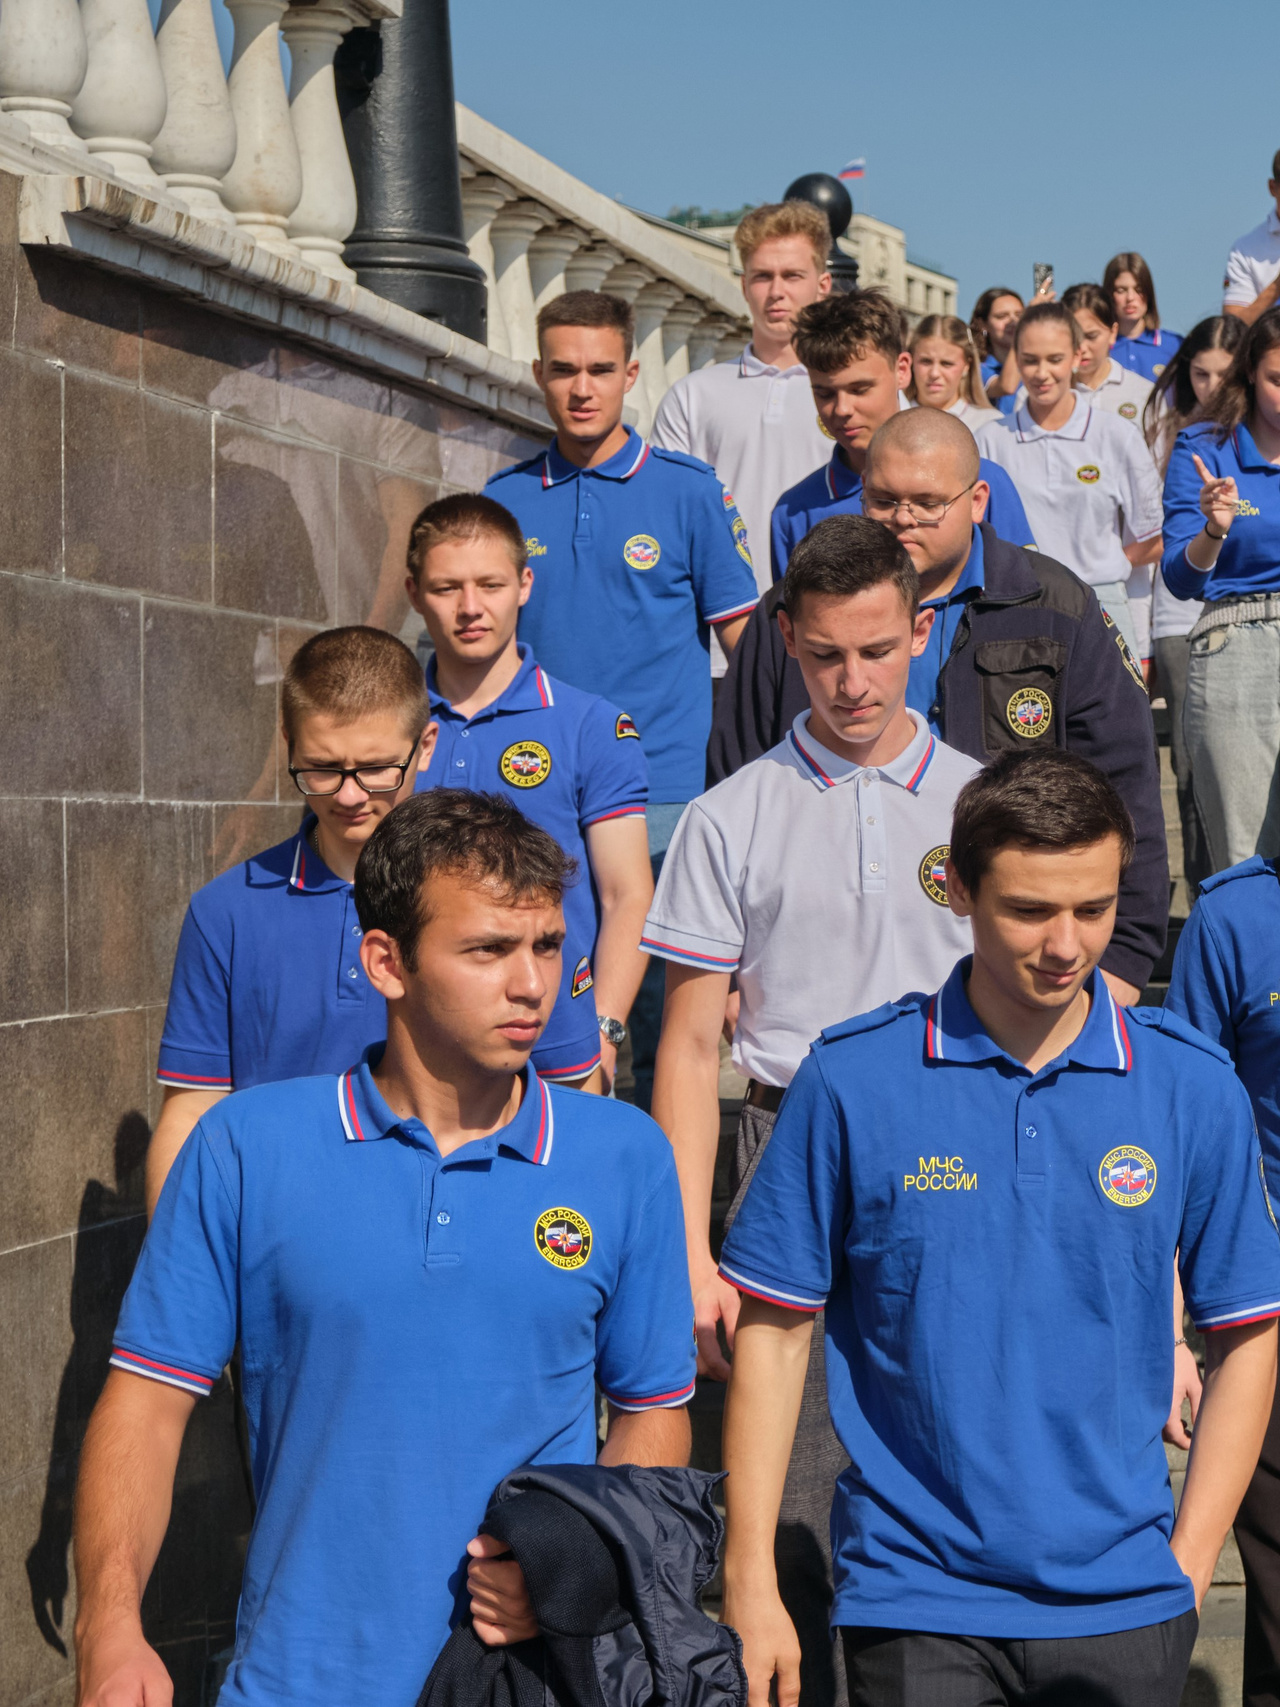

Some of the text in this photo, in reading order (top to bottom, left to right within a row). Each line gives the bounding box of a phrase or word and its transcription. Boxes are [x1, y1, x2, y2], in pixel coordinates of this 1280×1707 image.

[1010, 690, 1049, 712] МЧС РОССИИ
[1013, 719, 1048, 735] EMERCOM
[918, 1156, 964, 1174] МЧС
[1103, 1148, 1154, 1172] МЧС РОССИИ
[904, 1172, 978, 1192] РОССИИ
[1107, 1187, 1149, 1204] EMERCOM
[538, 1210, 590, 1238] МЧС РОССИИ
[542, 1246, 585, 1267] EMERCOM
